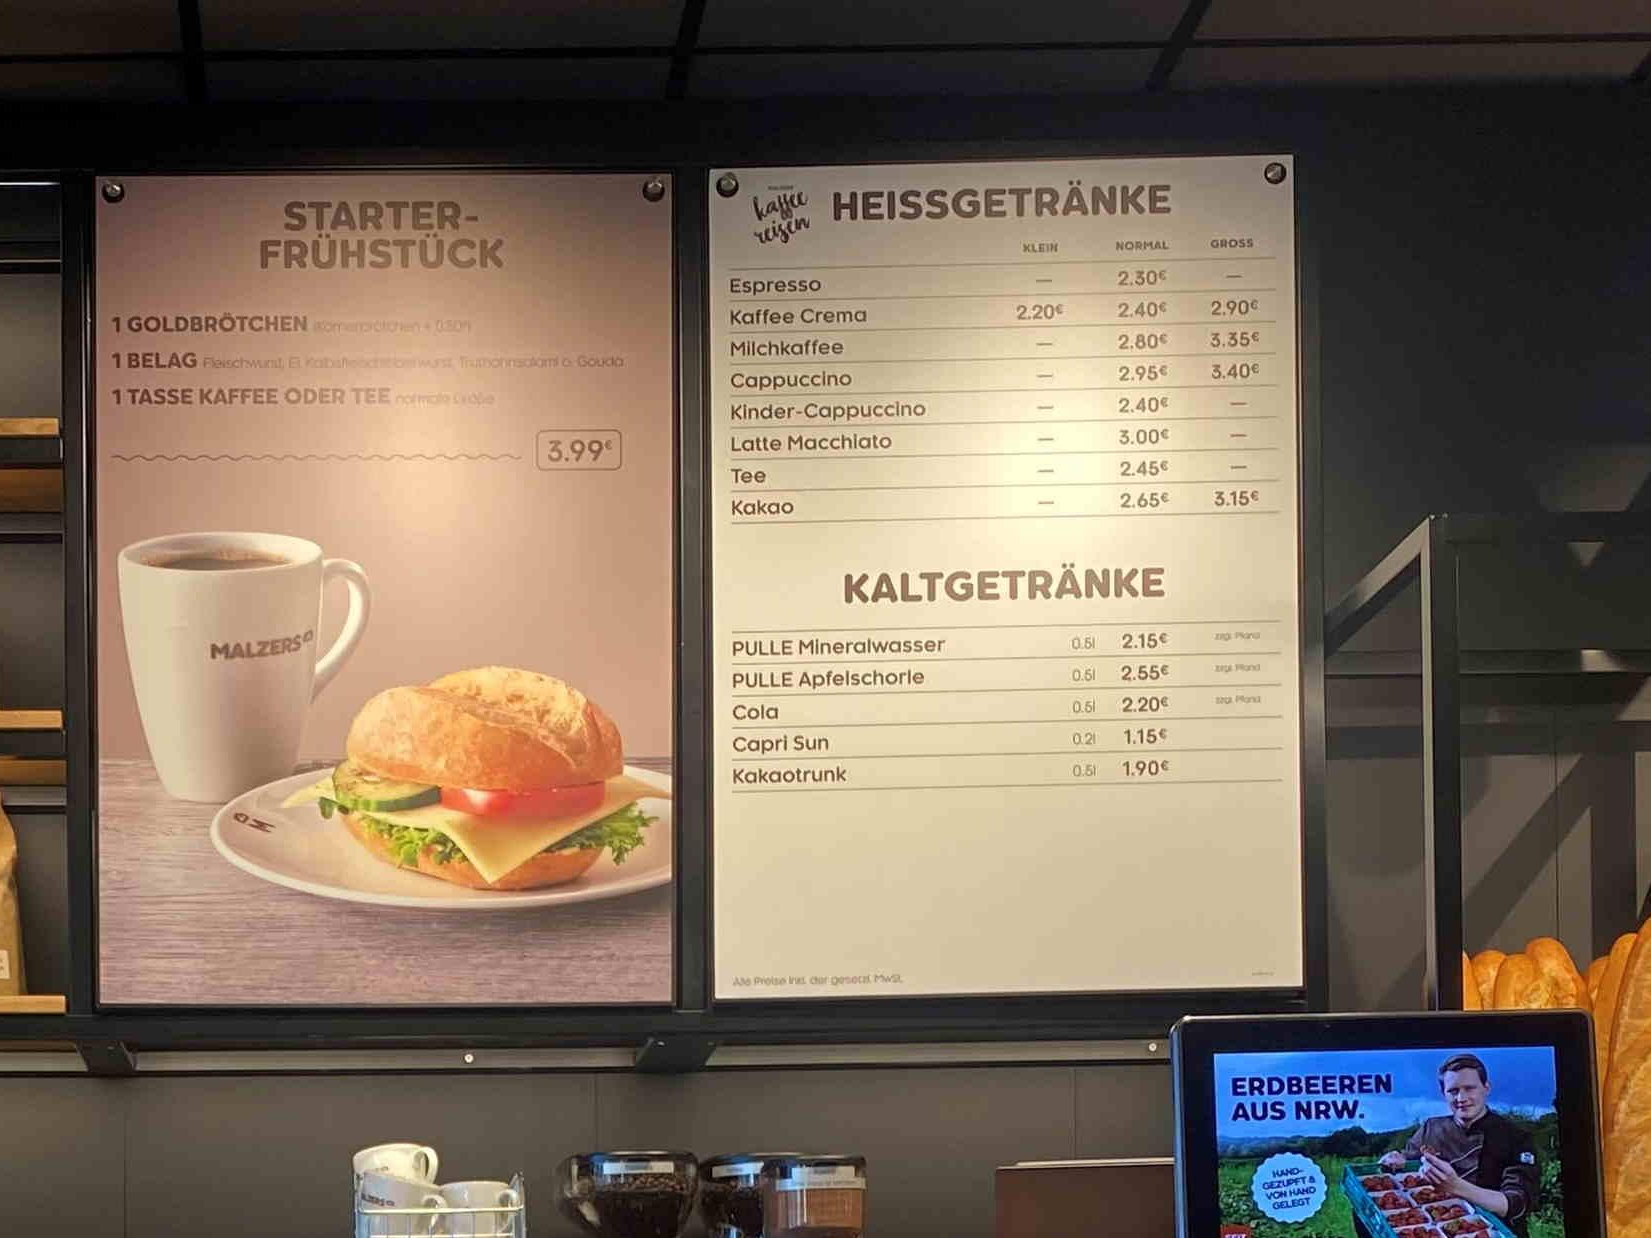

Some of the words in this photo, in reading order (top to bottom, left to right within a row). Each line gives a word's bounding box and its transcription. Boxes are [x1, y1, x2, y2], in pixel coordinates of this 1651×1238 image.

[752, 191, 809, 222] kaffee
[833, 181, 1172, 222] HEISSGETRÄNKE
[284, 200, 478, 231] STARTER-
[753, 217, 811, 244] reisen
[259, 234, 504, 269] FRÜHSTÜCK
[1023, 242, 1059, 254] KLEIN
[1116, 239, 1170, 251] NORMAL
[1211, 237, 1255, 249] GROSS
[729, 276, 822, 298] Espresso
[1117, 269, 1167, 288] 2.30€
[111, 317, 122, 332] 1
[127, 312, 308, 332] GOLDBRÖTCHEN
[729, 306, 795, 326] Kaffee
[801, 306, 867, 324] Crema
[1016, 303, 1064, 320] 2.20€
[1117, 300, 1168, 318] 2.40€
[1211, 299, 1259, 317] 2.90€
[730, 338, 844, 358] Milchkaffee
[1118, 332, 1168, 351] 2.80€
[1210, 330, 1260, 349] 3.35€
[111, 353, 122, 368] 1
[127, 352, 198, 369] BELAG
[577, 354, 624, 368] Gouda
[730, 370, 852, 392] Cappuccino
[1118, 364, 1168, 383] 2.95€
[1211, 363, 1260, 381] 3.40€
[111, 389, 122, 405] 1
[127, 388, 194, 405] TASSE
[199, 387, 279, 405] KAFFEE
[284, 387, 345, 405] ODER
[351, 386, 391, 405] TEE
[730, 400, 926, 424] Kinder-Cappuccino
[1118, 396, 1169, 415] 2.40€
[547, 438, 613, 462] 3.99€
[730, 433, 782, 453] Latte
[788, 431, 892, 452] Macchiato
[1119, 428, 1170, 446] 3.00€
[731, 467, 766, 485] Tee
[1120, 460, 1170, 478] 2.45€
[731, 498, 794, 517] Kakao
[1120, 492, 1170, 510] 2.65€
[1214, 490, 1259, 508] 3.15€
[844, 562, 1165, 605] KALTGETRÄNKE
[210, 634, 302, 660] MALZERS
[732, 639, 793, 657] PULLE
[798, 637, 946, 656] Mineralwasser
[1122, 632, 1168, 651] 2.15€
[732, 671, 793, 689] PULLE
[798, 668, 925, 691] Apfelschorle
[1121, 664, 1169, 683] 2.55€
[732, 703, 779, 721] Cola
[1122, 696, 1169, 713] 2.20€
[732, 735, 788, 755] Capri
[794, 734, 829, 752] Sun
[1123, 728, 1168, 745] 1.15€
[732, 766, 847, 785] Kakaotrunk
[1122, 760, 1169, 778] 1.90€
[1231, 1073, 1393, 1097] ERDBEEREN
[1231, 1101, 1287, 1122] AUS
[1294, 1100, 1365, 1121] NRW.
[1262, 1176, 1307, 1190] GEZUPFT
[1272, 1167, 1305, 1178] HAND-
[1266, 1191, 1288, 1201] VON
[1289, 1186, 1317, 1197] HAND
[1272, 1197, 1311, 1210] GELEGT
